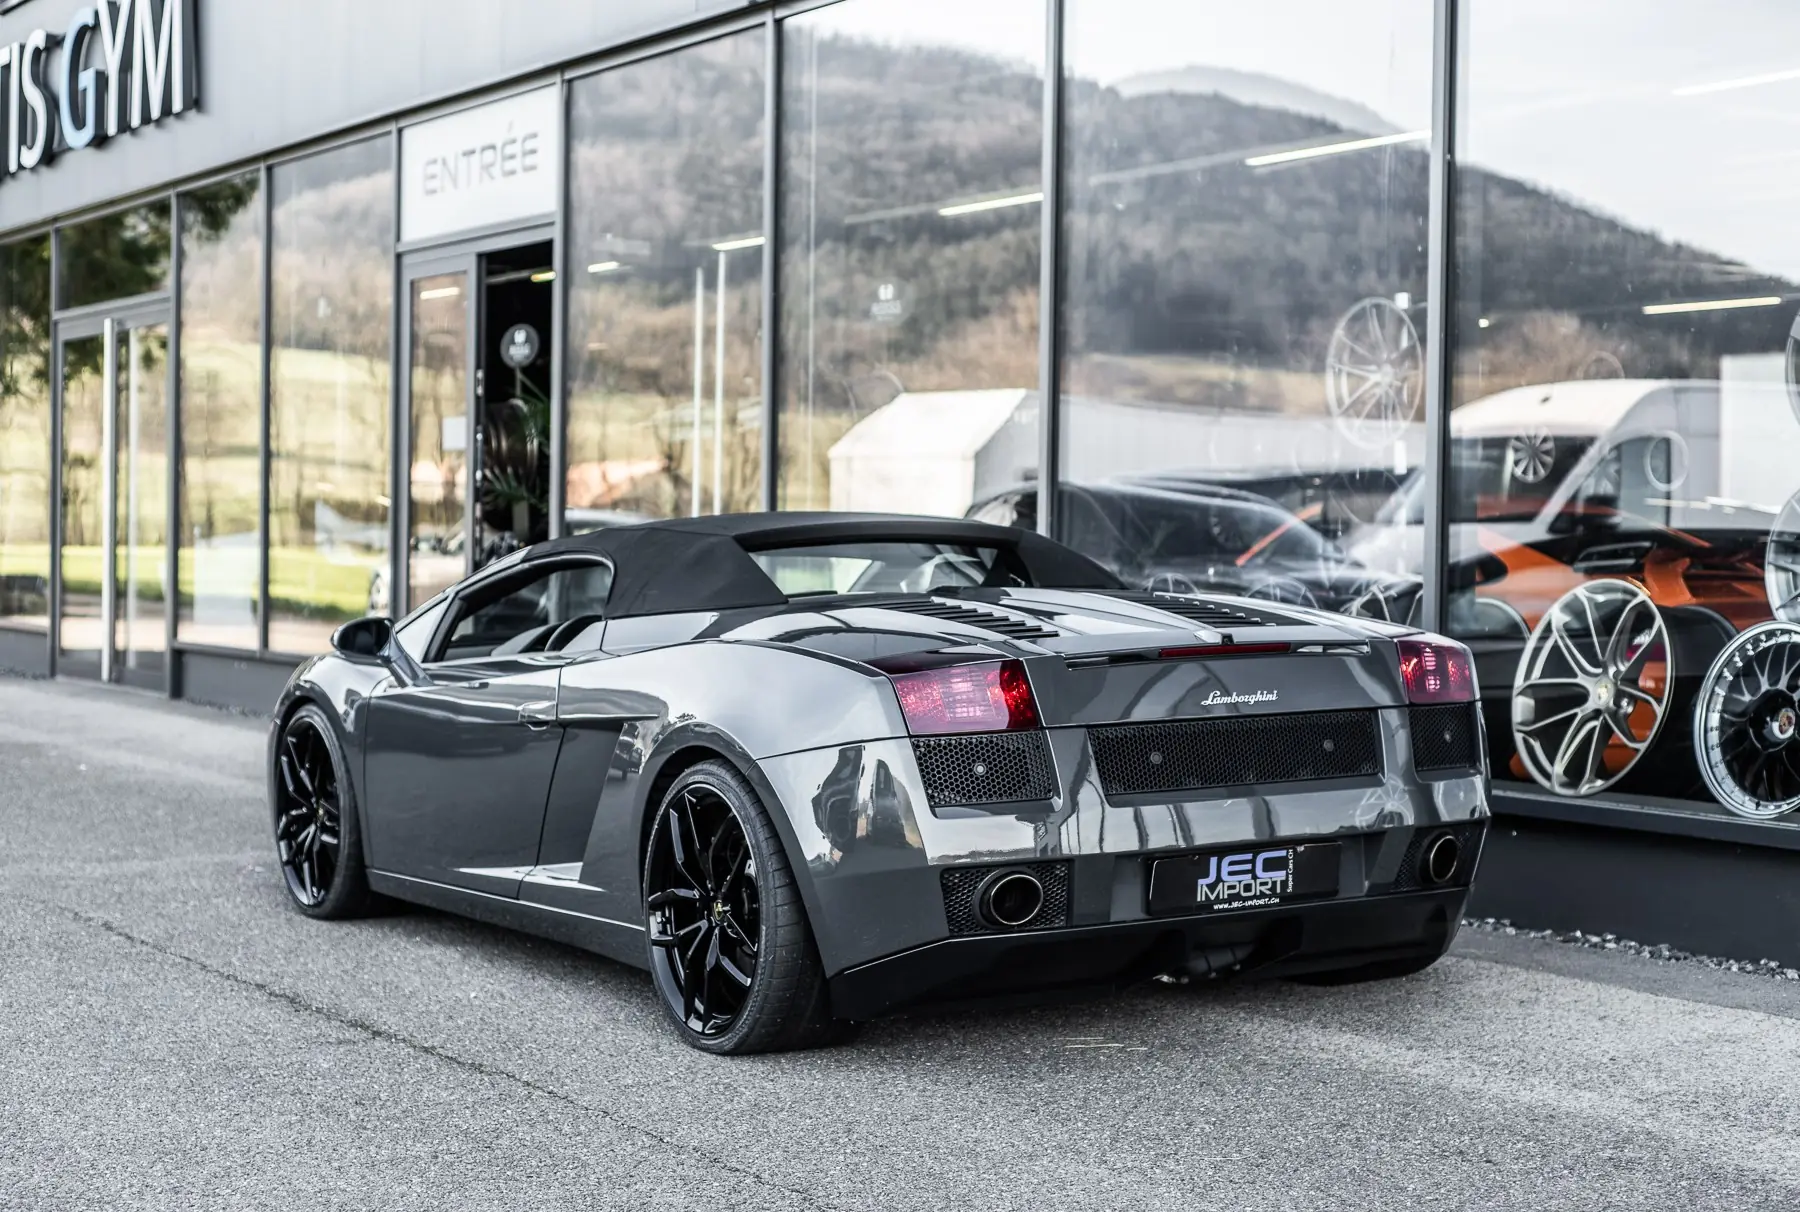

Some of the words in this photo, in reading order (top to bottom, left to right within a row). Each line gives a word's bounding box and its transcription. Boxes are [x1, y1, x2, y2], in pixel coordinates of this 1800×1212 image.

[58, 0, 184, 149] GYM
[424, 120, 539, 196] ENTRÉE
[1200, 690, 1279, 706] Lamborghini
[1197, 850, 1288, 885] JEC
[1287, 849, 1294, 859] CH
[1196, 877, 1287, 902] IMPORT
